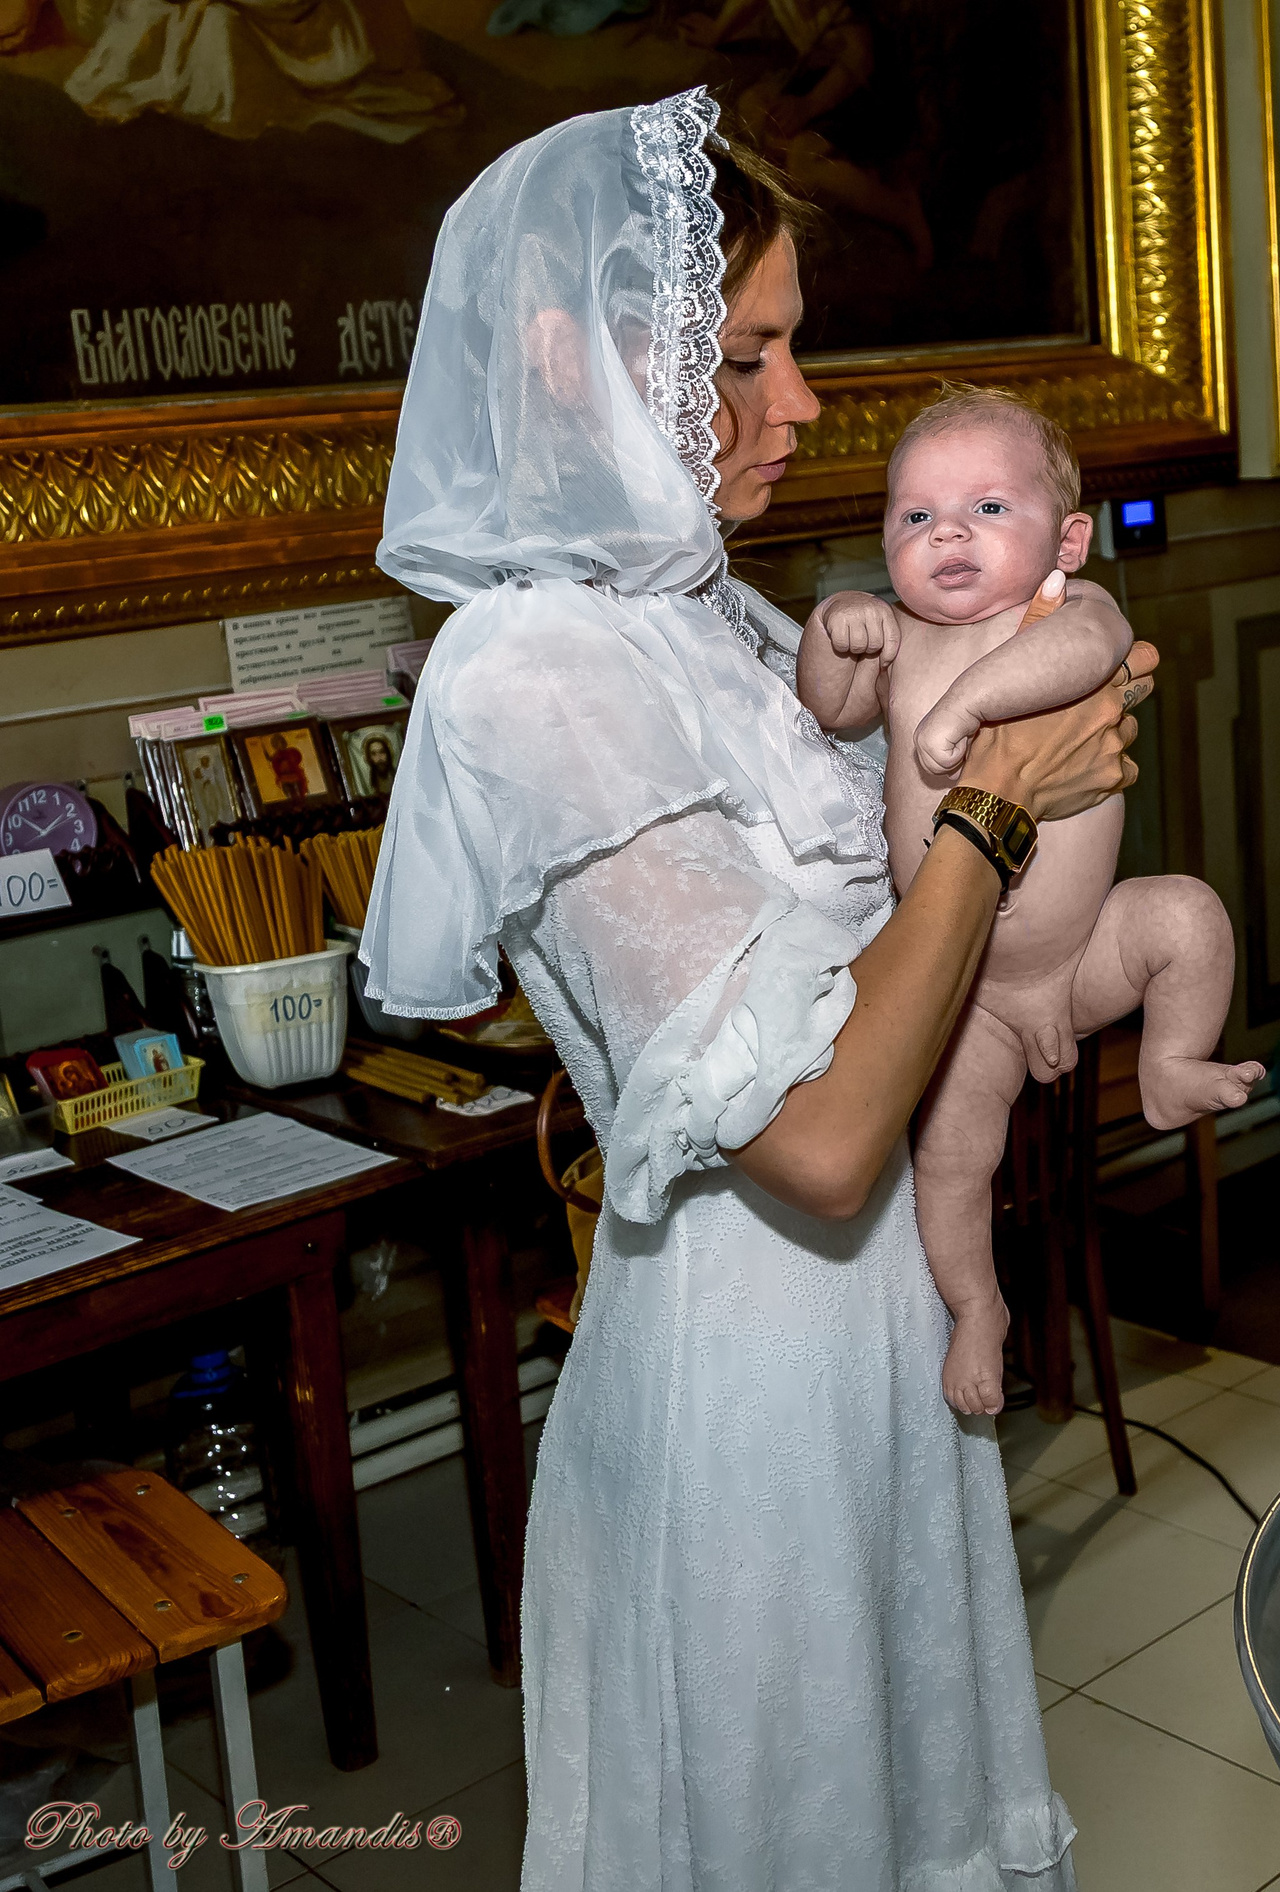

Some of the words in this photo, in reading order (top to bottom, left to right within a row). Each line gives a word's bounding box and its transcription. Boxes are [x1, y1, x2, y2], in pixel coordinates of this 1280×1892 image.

[337, 300, 419, 376] ДЕТЕ
[18, 797, 30, 812] 11
[29, 789, 47, 805] 12
[52, 791, 61, 806] 1
[65, 802, 78, 818] 2
[8, 813, 22, 829] 10
[73, 819, 85, 835] 3
[0, 870, 59, 908] 00=
